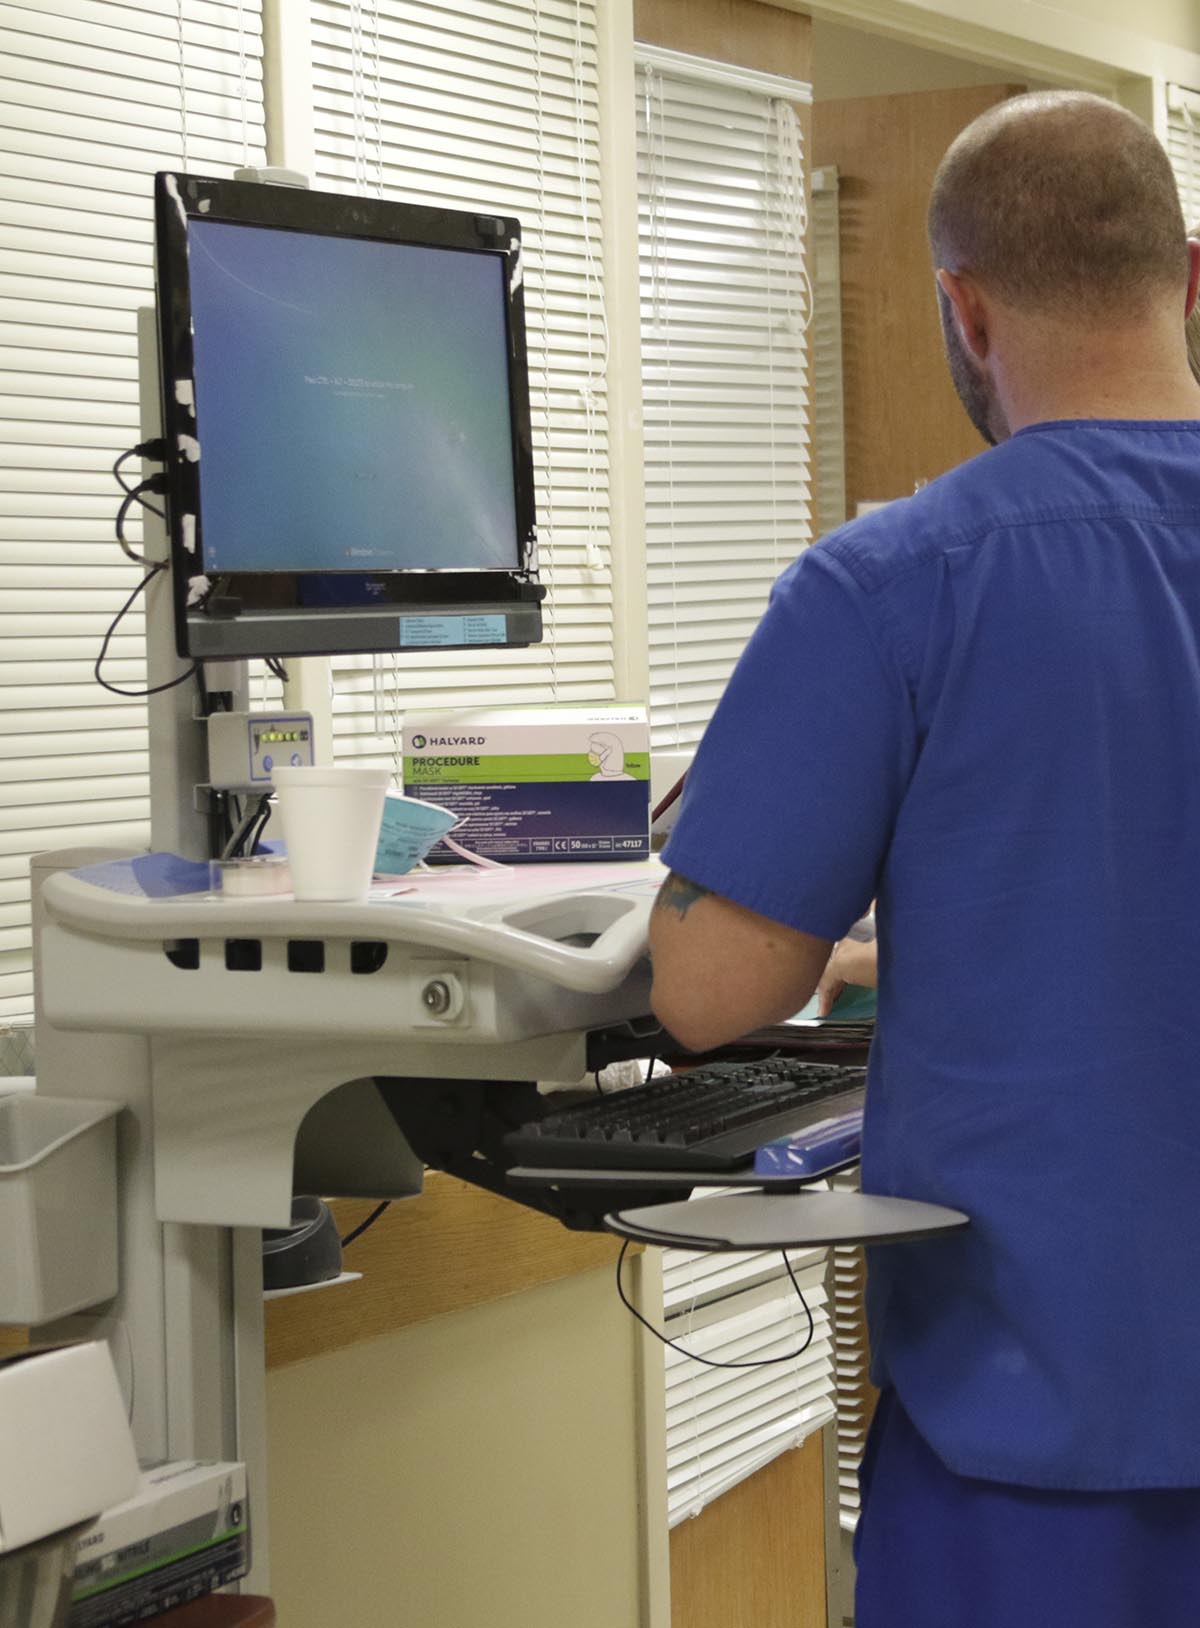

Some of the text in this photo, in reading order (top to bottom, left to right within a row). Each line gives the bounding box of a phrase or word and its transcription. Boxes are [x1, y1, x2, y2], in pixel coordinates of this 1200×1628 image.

[429, 736, 486, 746] HALYARD
[412, 756, 481, 767] PROCEDURE
[412, 767, 442, 776] MASK
[570, 840, 581, 849] 50
[622, 839, 642, 849] 47117
